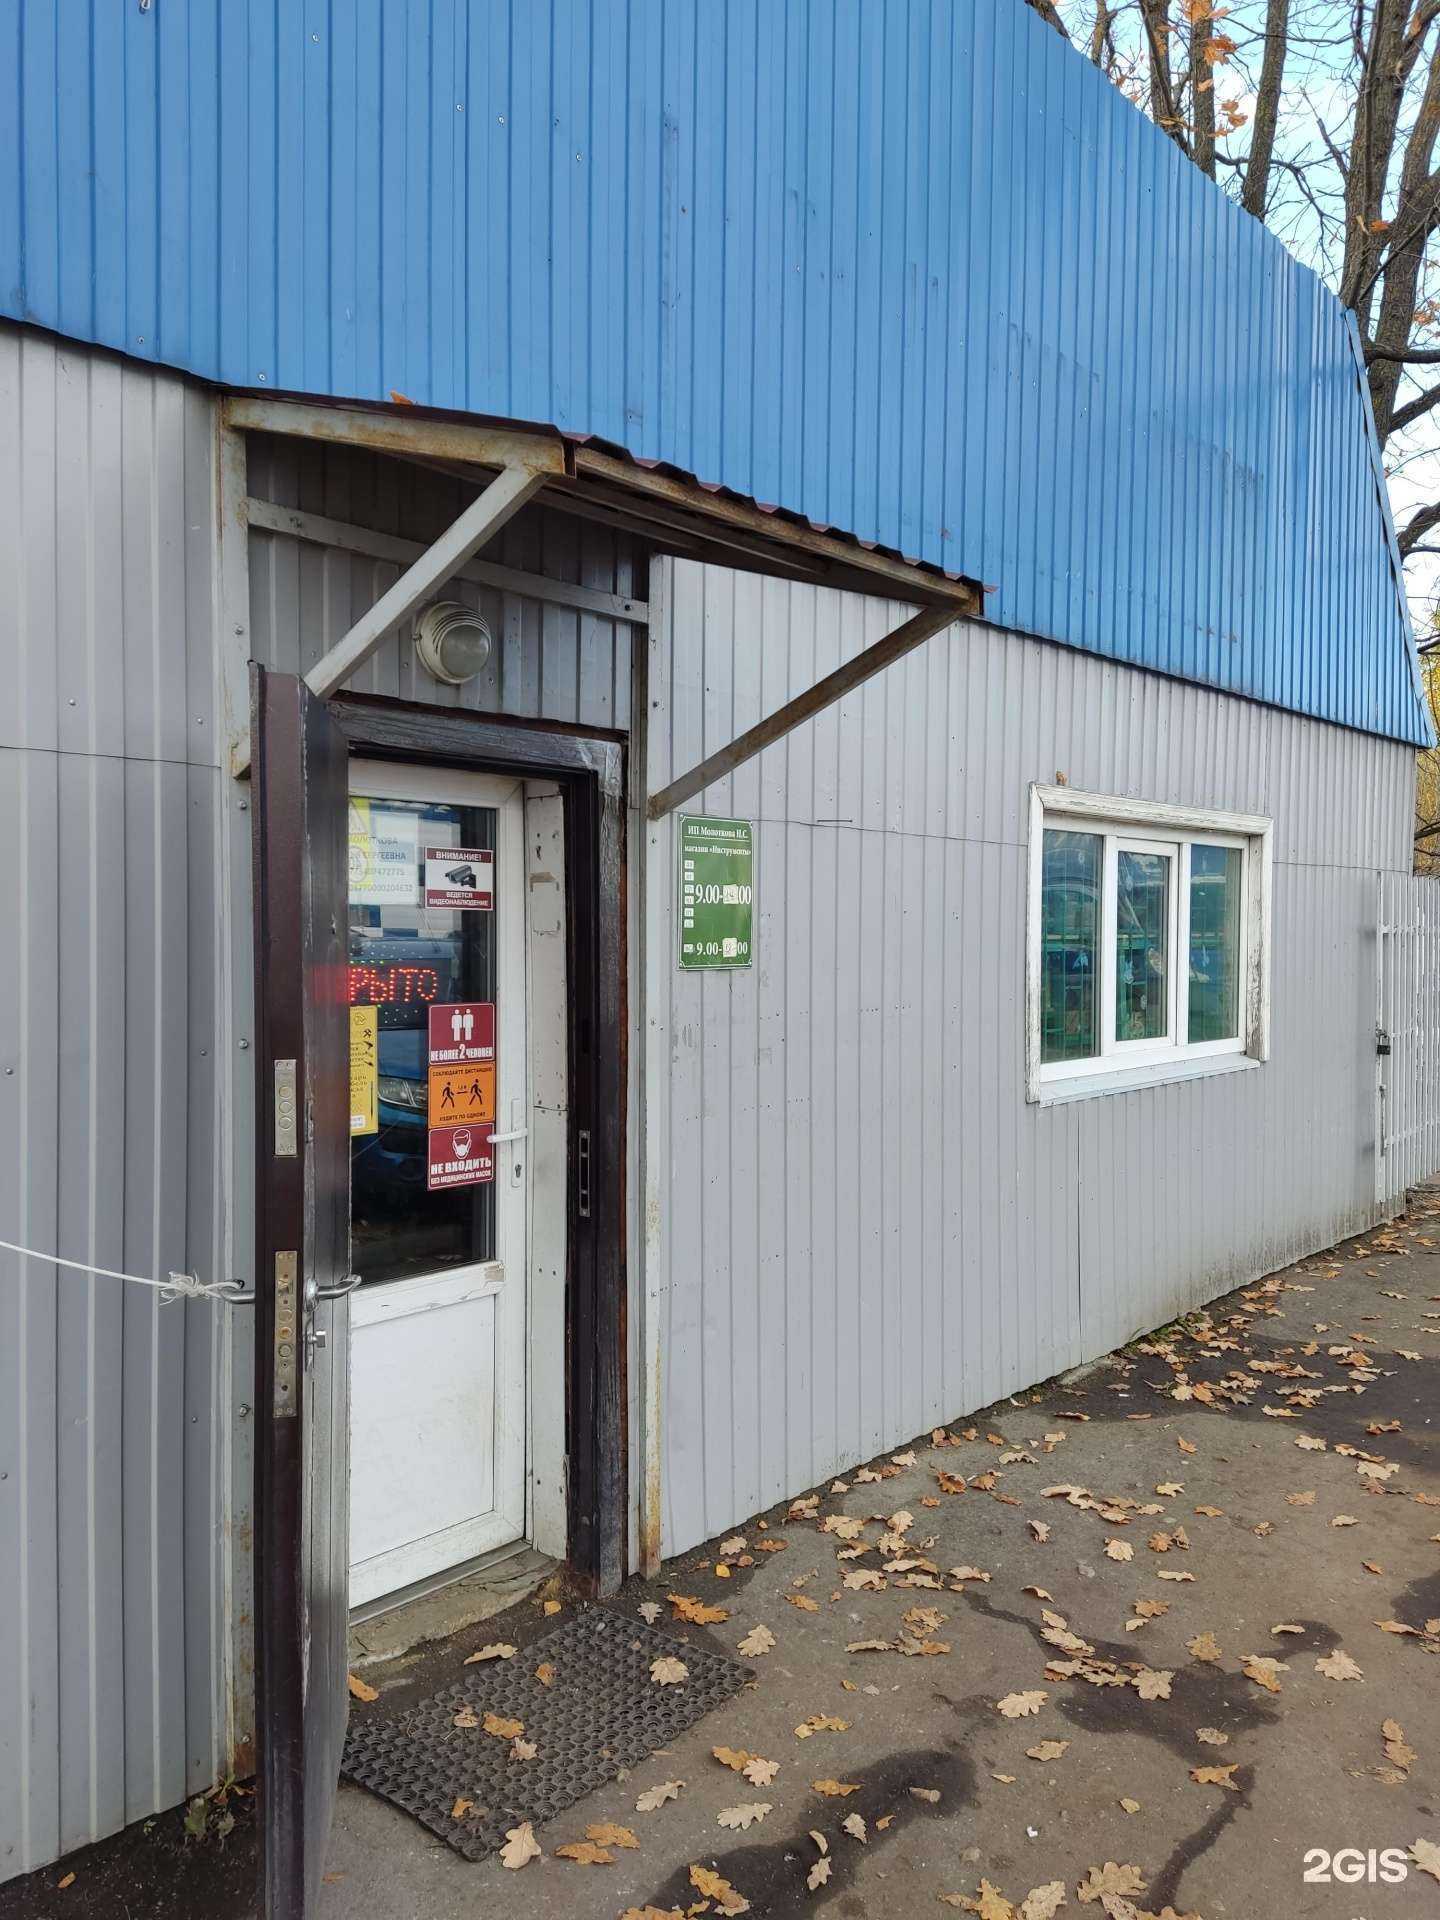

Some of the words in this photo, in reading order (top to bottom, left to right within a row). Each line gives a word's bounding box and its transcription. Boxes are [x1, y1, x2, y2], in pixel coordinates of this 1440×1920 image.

[688, 825, 699, 835] ИП
[684, 845, 709, 853] магазин
[435, 851, 482, 861] ВНИМАНИЕ!
[446, 891, 473, 899] ВЕДЕТСЯ
[429, 898, 489, 907] ВИДЕОНАБЛЮДЕНИЕ
[430, 1050, 439, 1061] НЕ
[439, 1049, 459, 1060] БОЛЕЕ
[459, 1043, 466, 1059] 2
[466, 1047, 493, 1059] ЧЕЛОВЕК
[432, 1069, 464, 1077] СОБЛЮДАЙТЕ
[467, 1111, 486, 1119] ОДНОМУ
[430, 1163, 444, 1175] НЕ
[445, 1157, 491, 1173] ВХОДИТЬ
[430, 1177, 440, 1185] БЕЗ
[440, 1172, 475, 1183] МЕДИЦИНСКИХ
[475, 1169, 491, 1178] МАСОК
